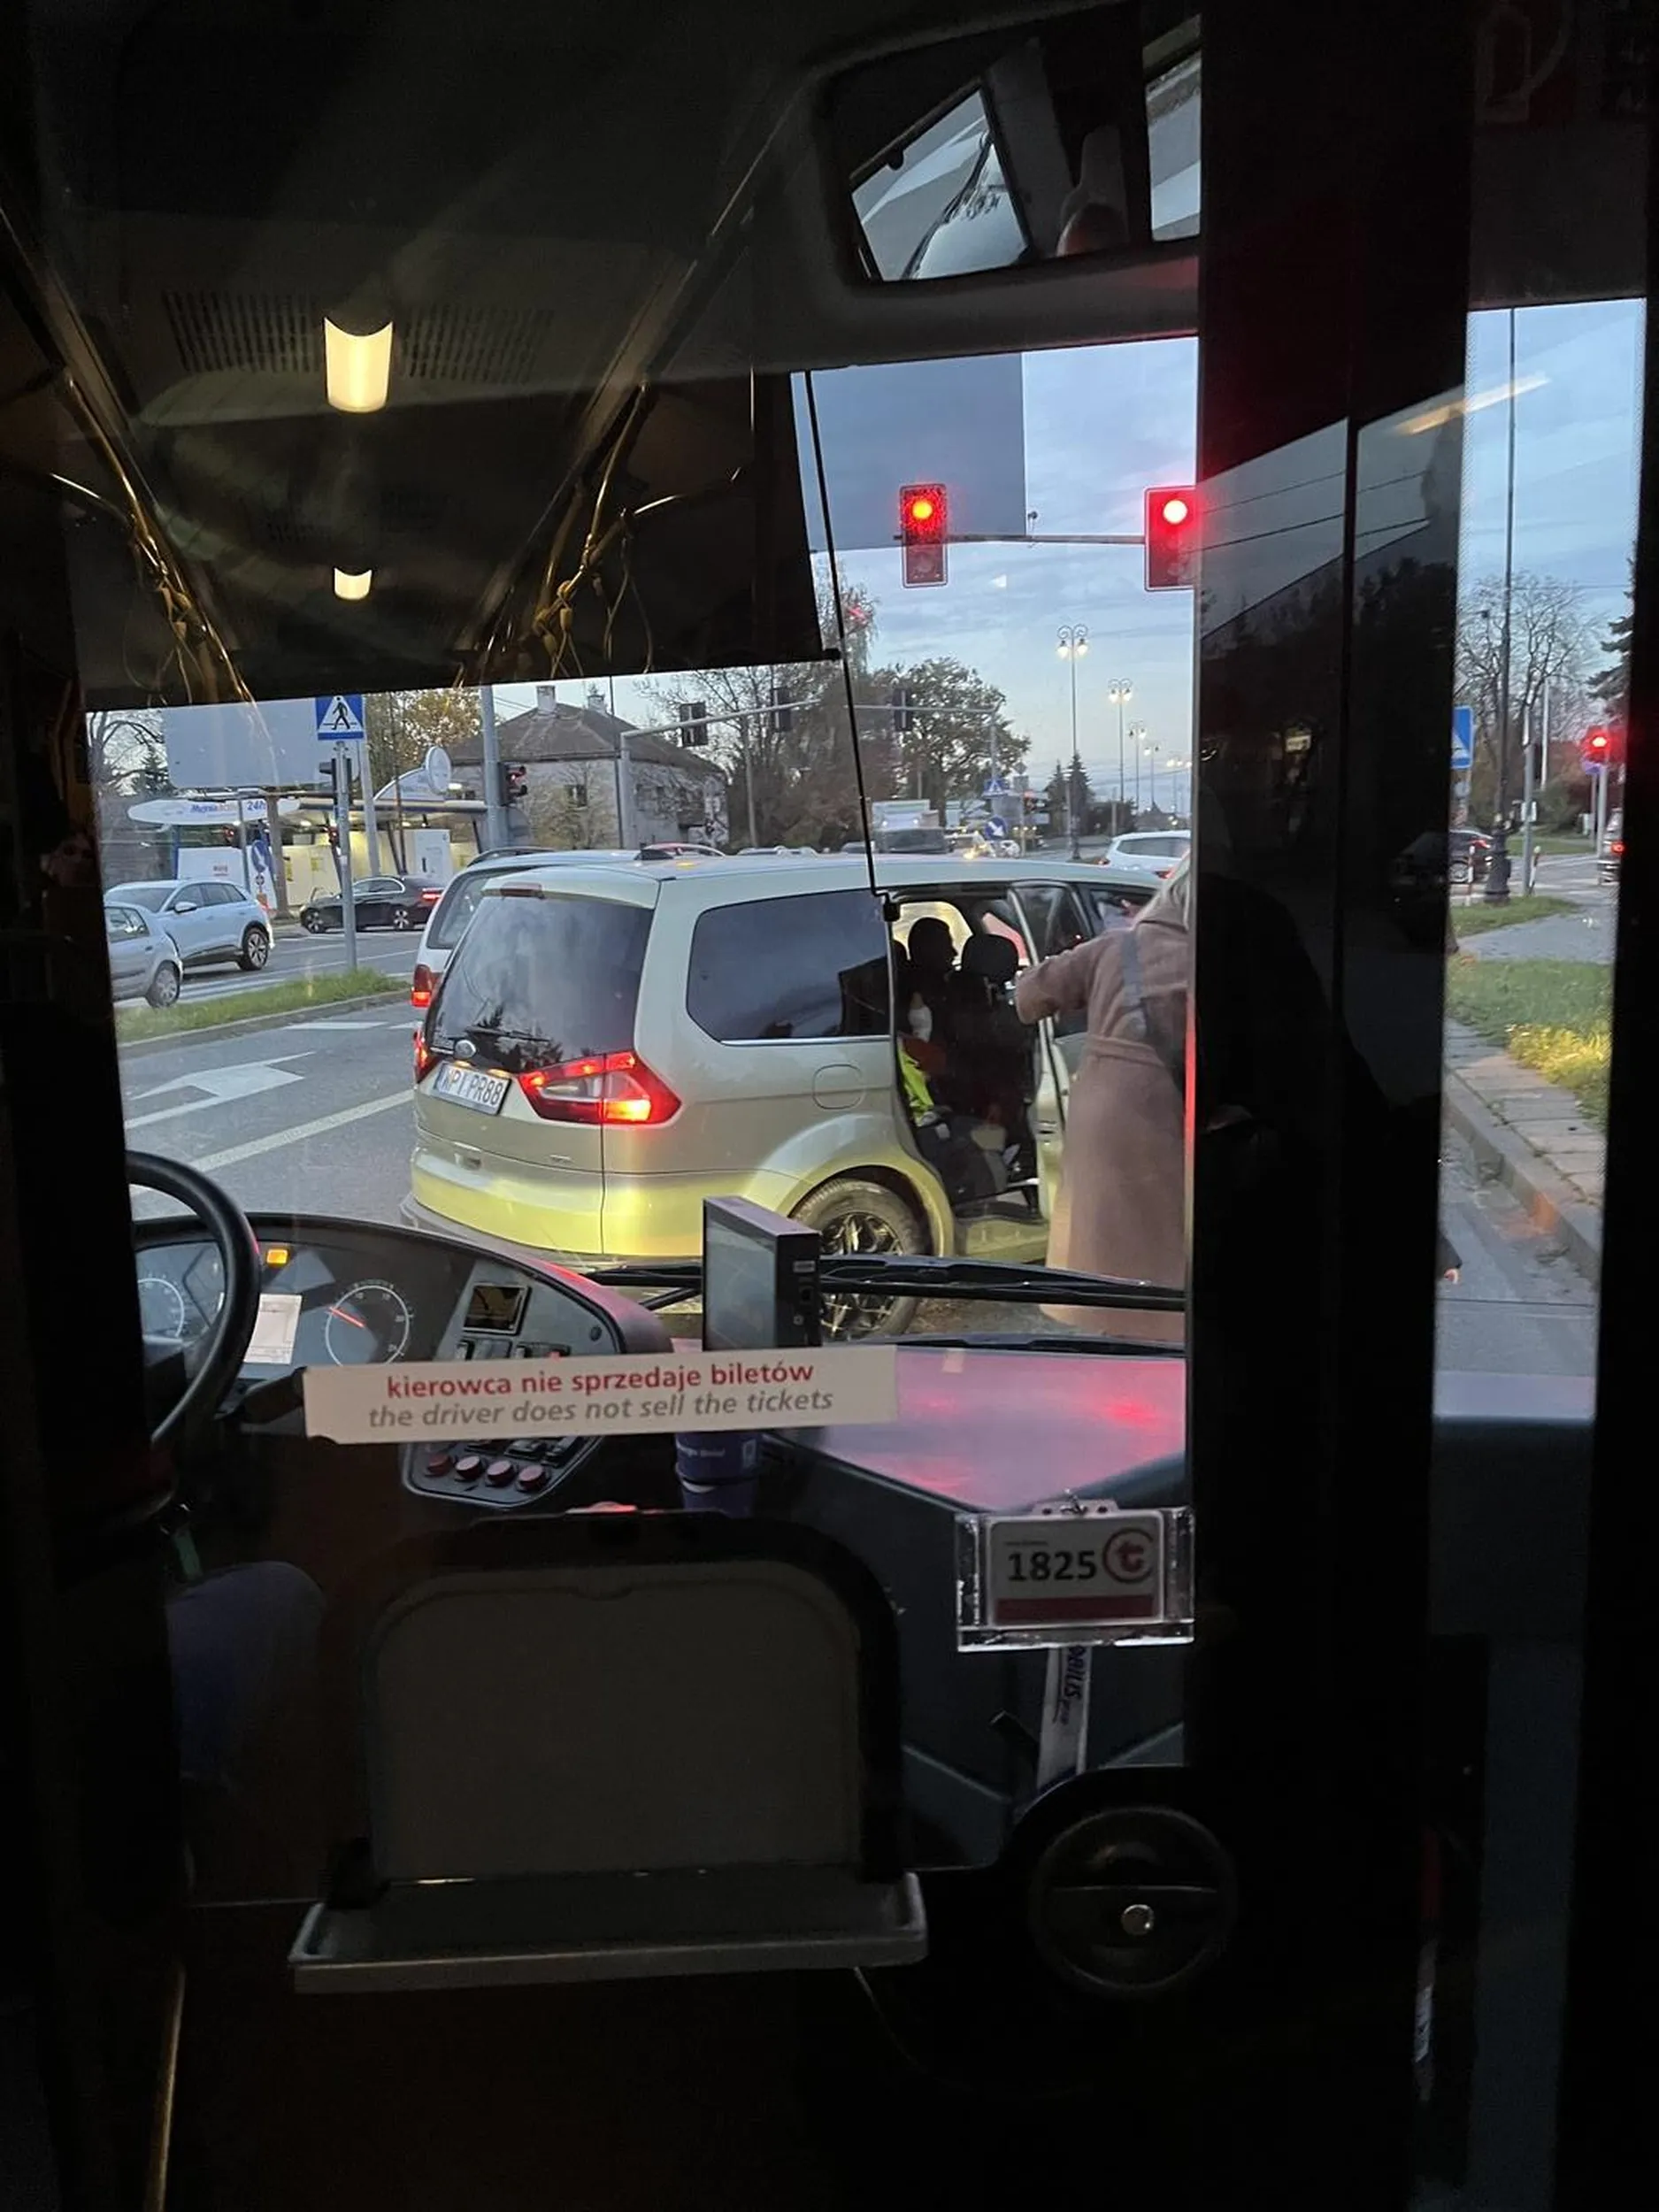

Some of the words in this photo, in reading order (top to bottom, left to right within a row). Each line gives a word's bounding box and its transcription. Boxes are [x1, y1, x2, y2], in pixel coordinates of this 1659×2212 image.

[387, 1376, 511, 1398] kierowca
[522, 1371, 563, 1393] nie
[572, 1365, 702, 1394] sprzedaje
[711, 1360, 814, 1386] biletów
[369, 1404, 412, 1427] the
[422, 1401, 505, 1426] driver
[512, 1401, 576, 1423] does
[586, 1398, 634, 1419] not
[641, 1394, 684, 1417] sell
[695, 1393, 737, 1415] the
[747, 1390, 834, 1412] tickets
[1008, 1549, 1097, 1582] 1825
